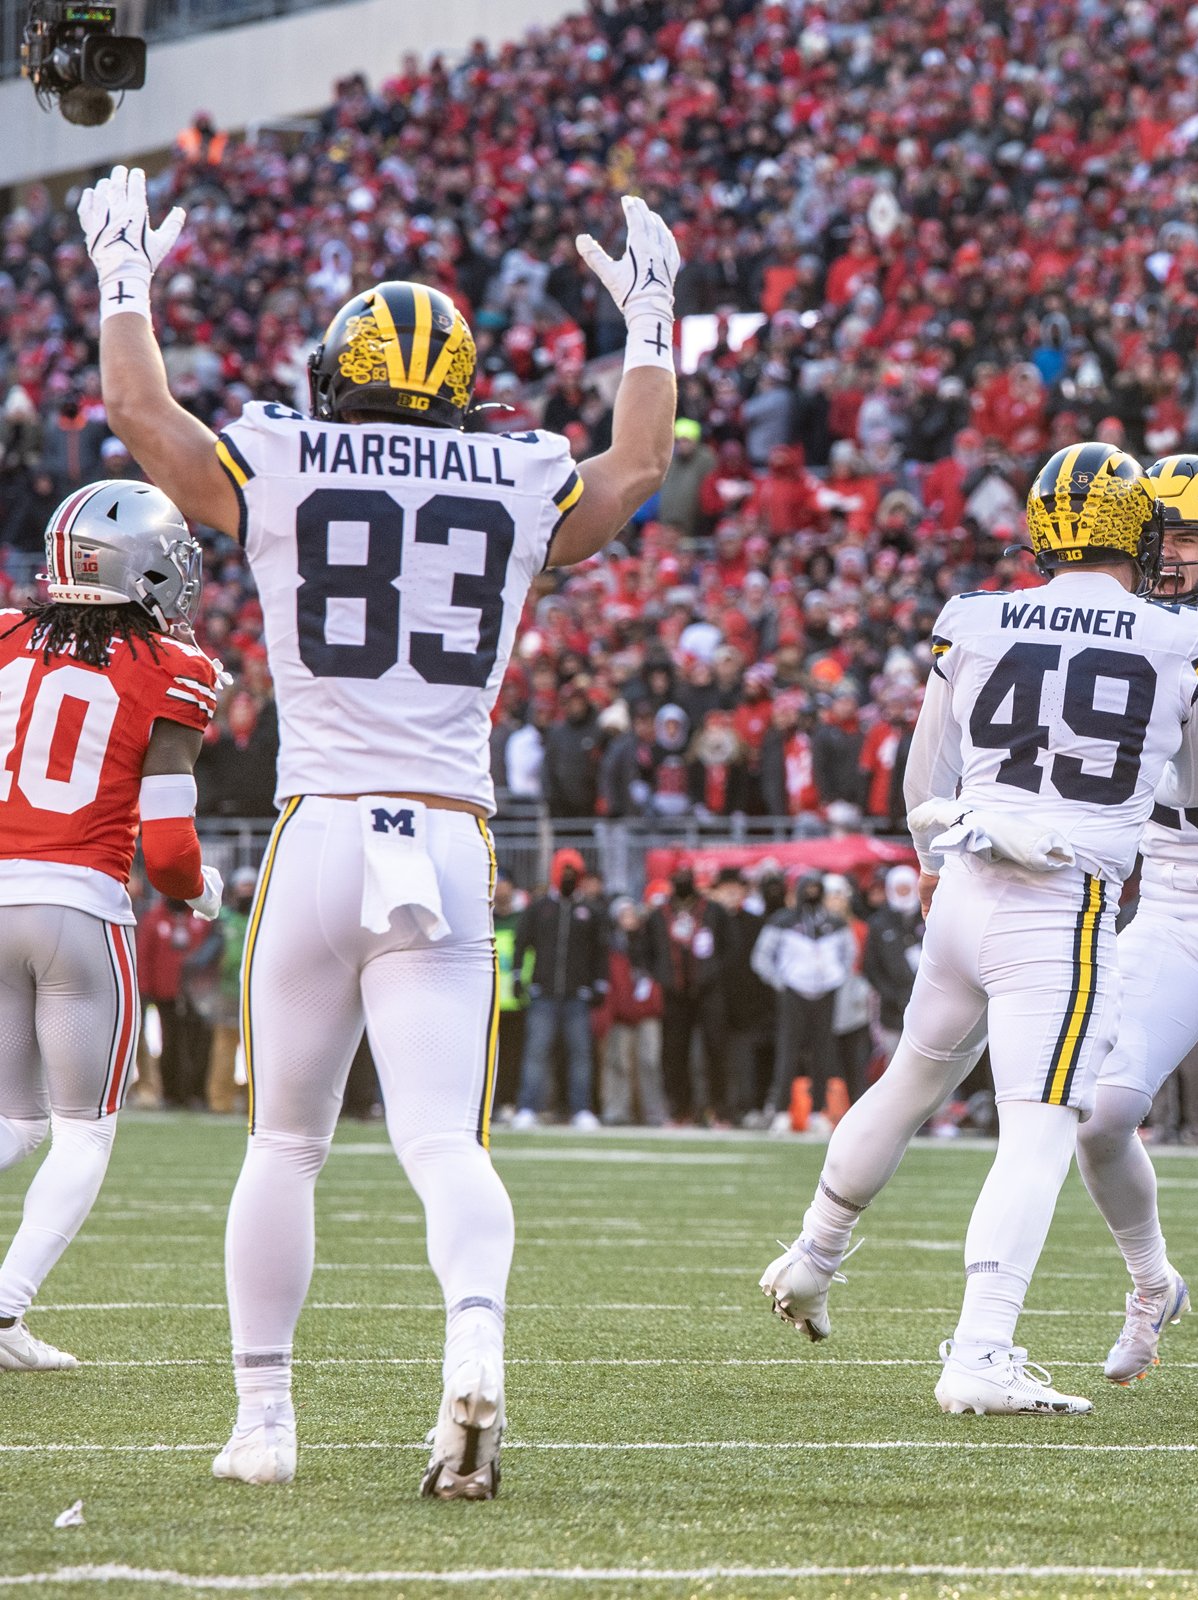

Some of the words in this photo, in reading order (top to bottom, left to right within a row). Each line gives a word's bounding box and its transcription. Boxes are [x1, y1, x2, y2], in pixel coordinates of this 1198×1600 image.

[299, 430, 516, 488] MARSHALL
[295, 487, 516, 689] 83
[1000, 601, 1138, 641] WAGNER
[0, 656, 120, 815] 10
[969, 640, 1159, 807] 49
[371, 808, 415, 837] M
